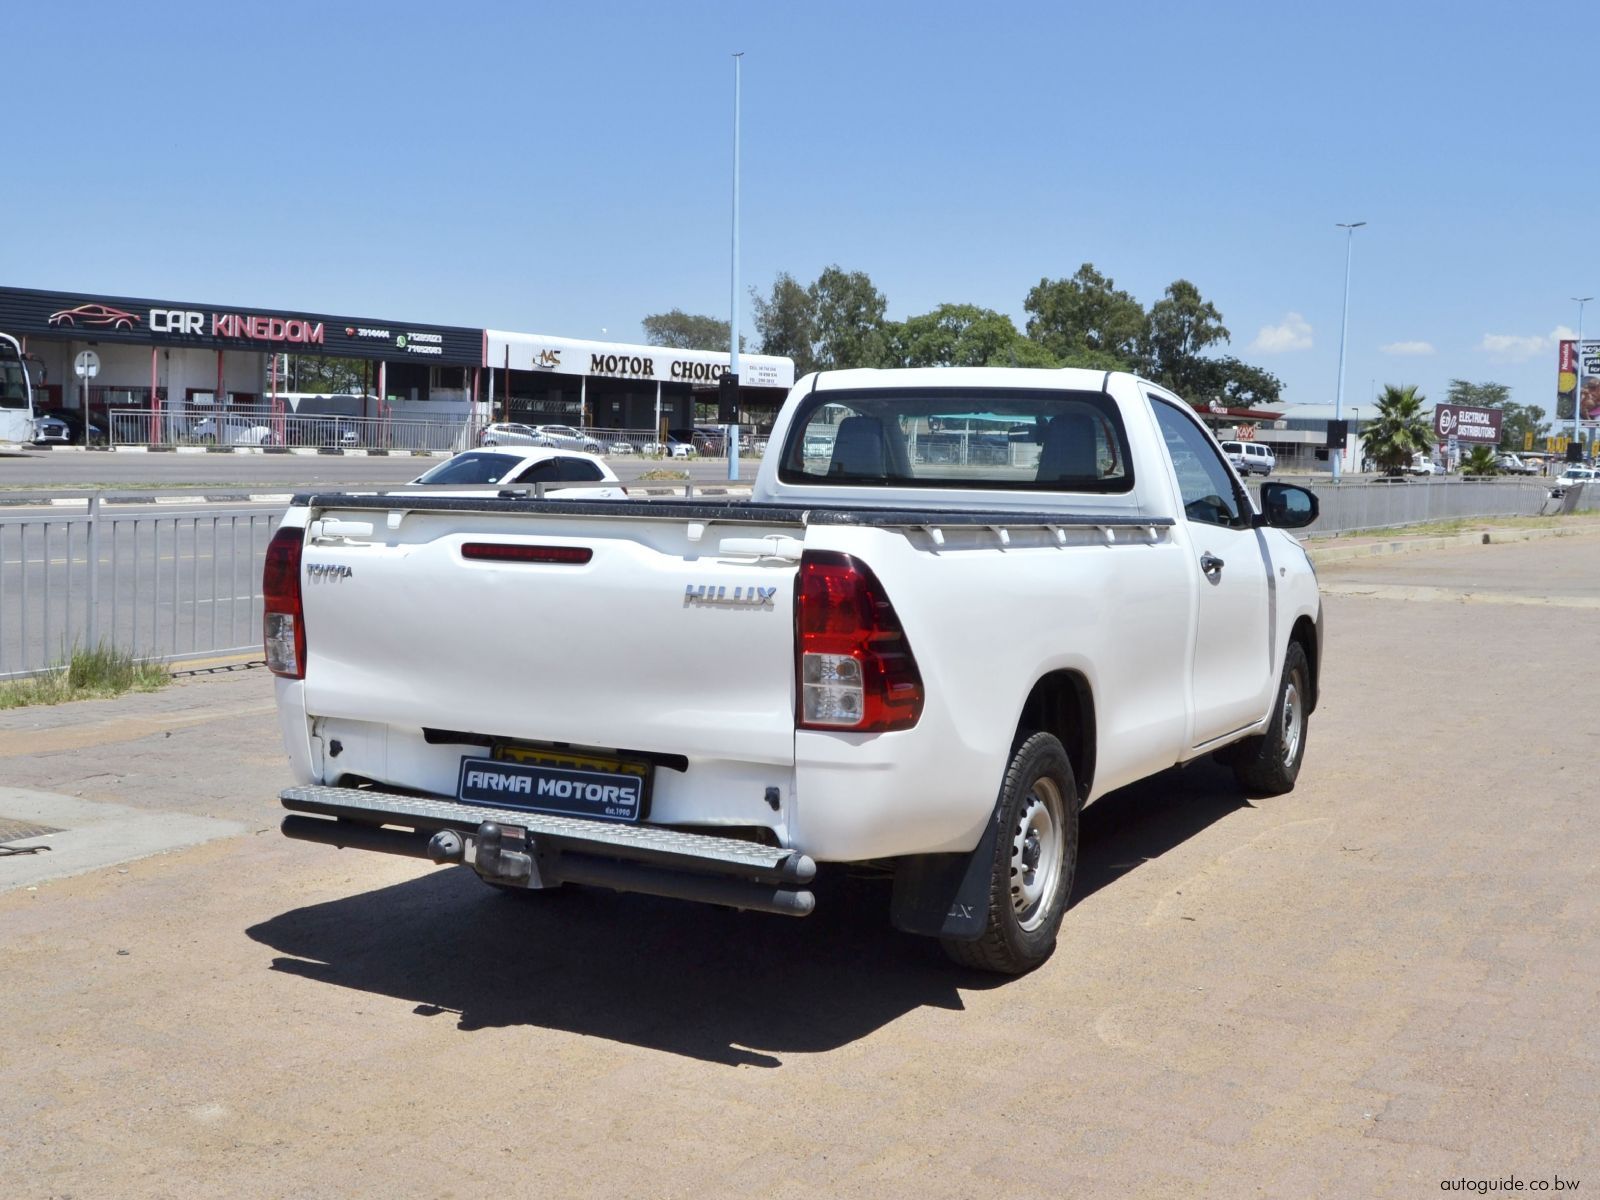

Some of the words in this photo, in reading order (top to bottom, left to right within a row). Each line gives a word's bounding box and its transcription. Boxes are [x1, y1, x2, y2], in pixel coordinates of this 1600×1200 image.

[149, 309, 204, 335] CAR
[212, 313, 323, 344] KINGDOM
[590, 354, 654, 375] MOTOR
[1459, 411, 1490, 425] ELECTRICAL
[1457, 425, 1496, 439] DISTRIBUTORS
[307, 563, 352, 578] TOYOTA
[684, 584, 776, 606] HILUX
[467, 771, 532, 794] ARMA
[537, 778, 636, 806] MOTORS
